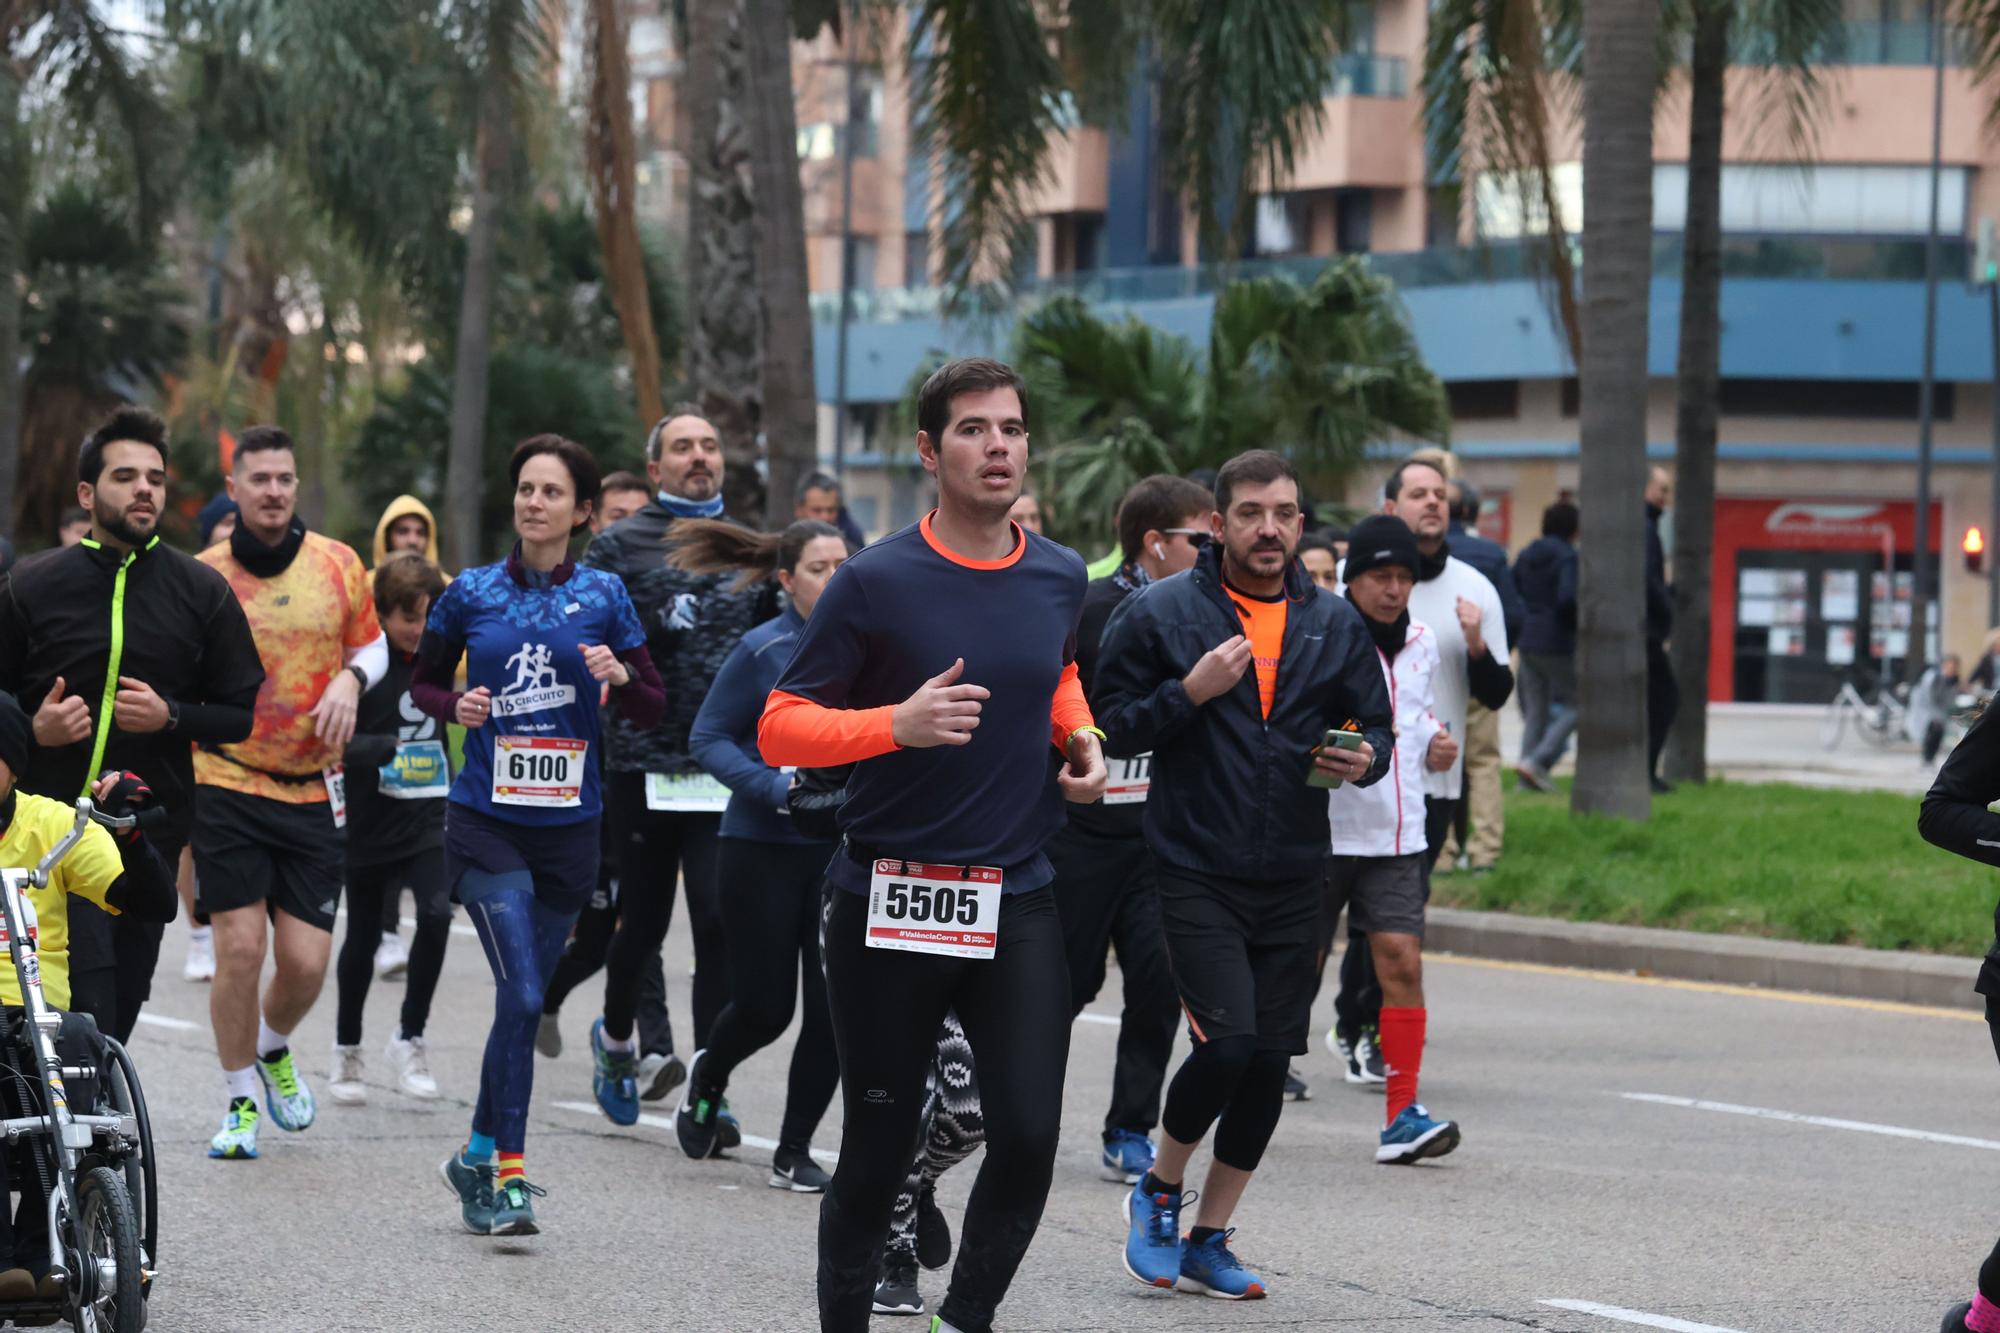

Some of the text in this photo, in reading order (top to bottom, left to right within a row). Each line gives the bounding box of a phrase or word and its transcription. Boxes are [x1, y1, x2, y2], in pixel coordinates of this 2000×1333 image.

[498, 699, 514, 713] 16
[515, 690, 565, 706] CIRCUITO
[509, 753, 568, 782] 6100
[886, 883, 978, 925] 5505
[899, 930, 958, 942] #ValènciaCorre
